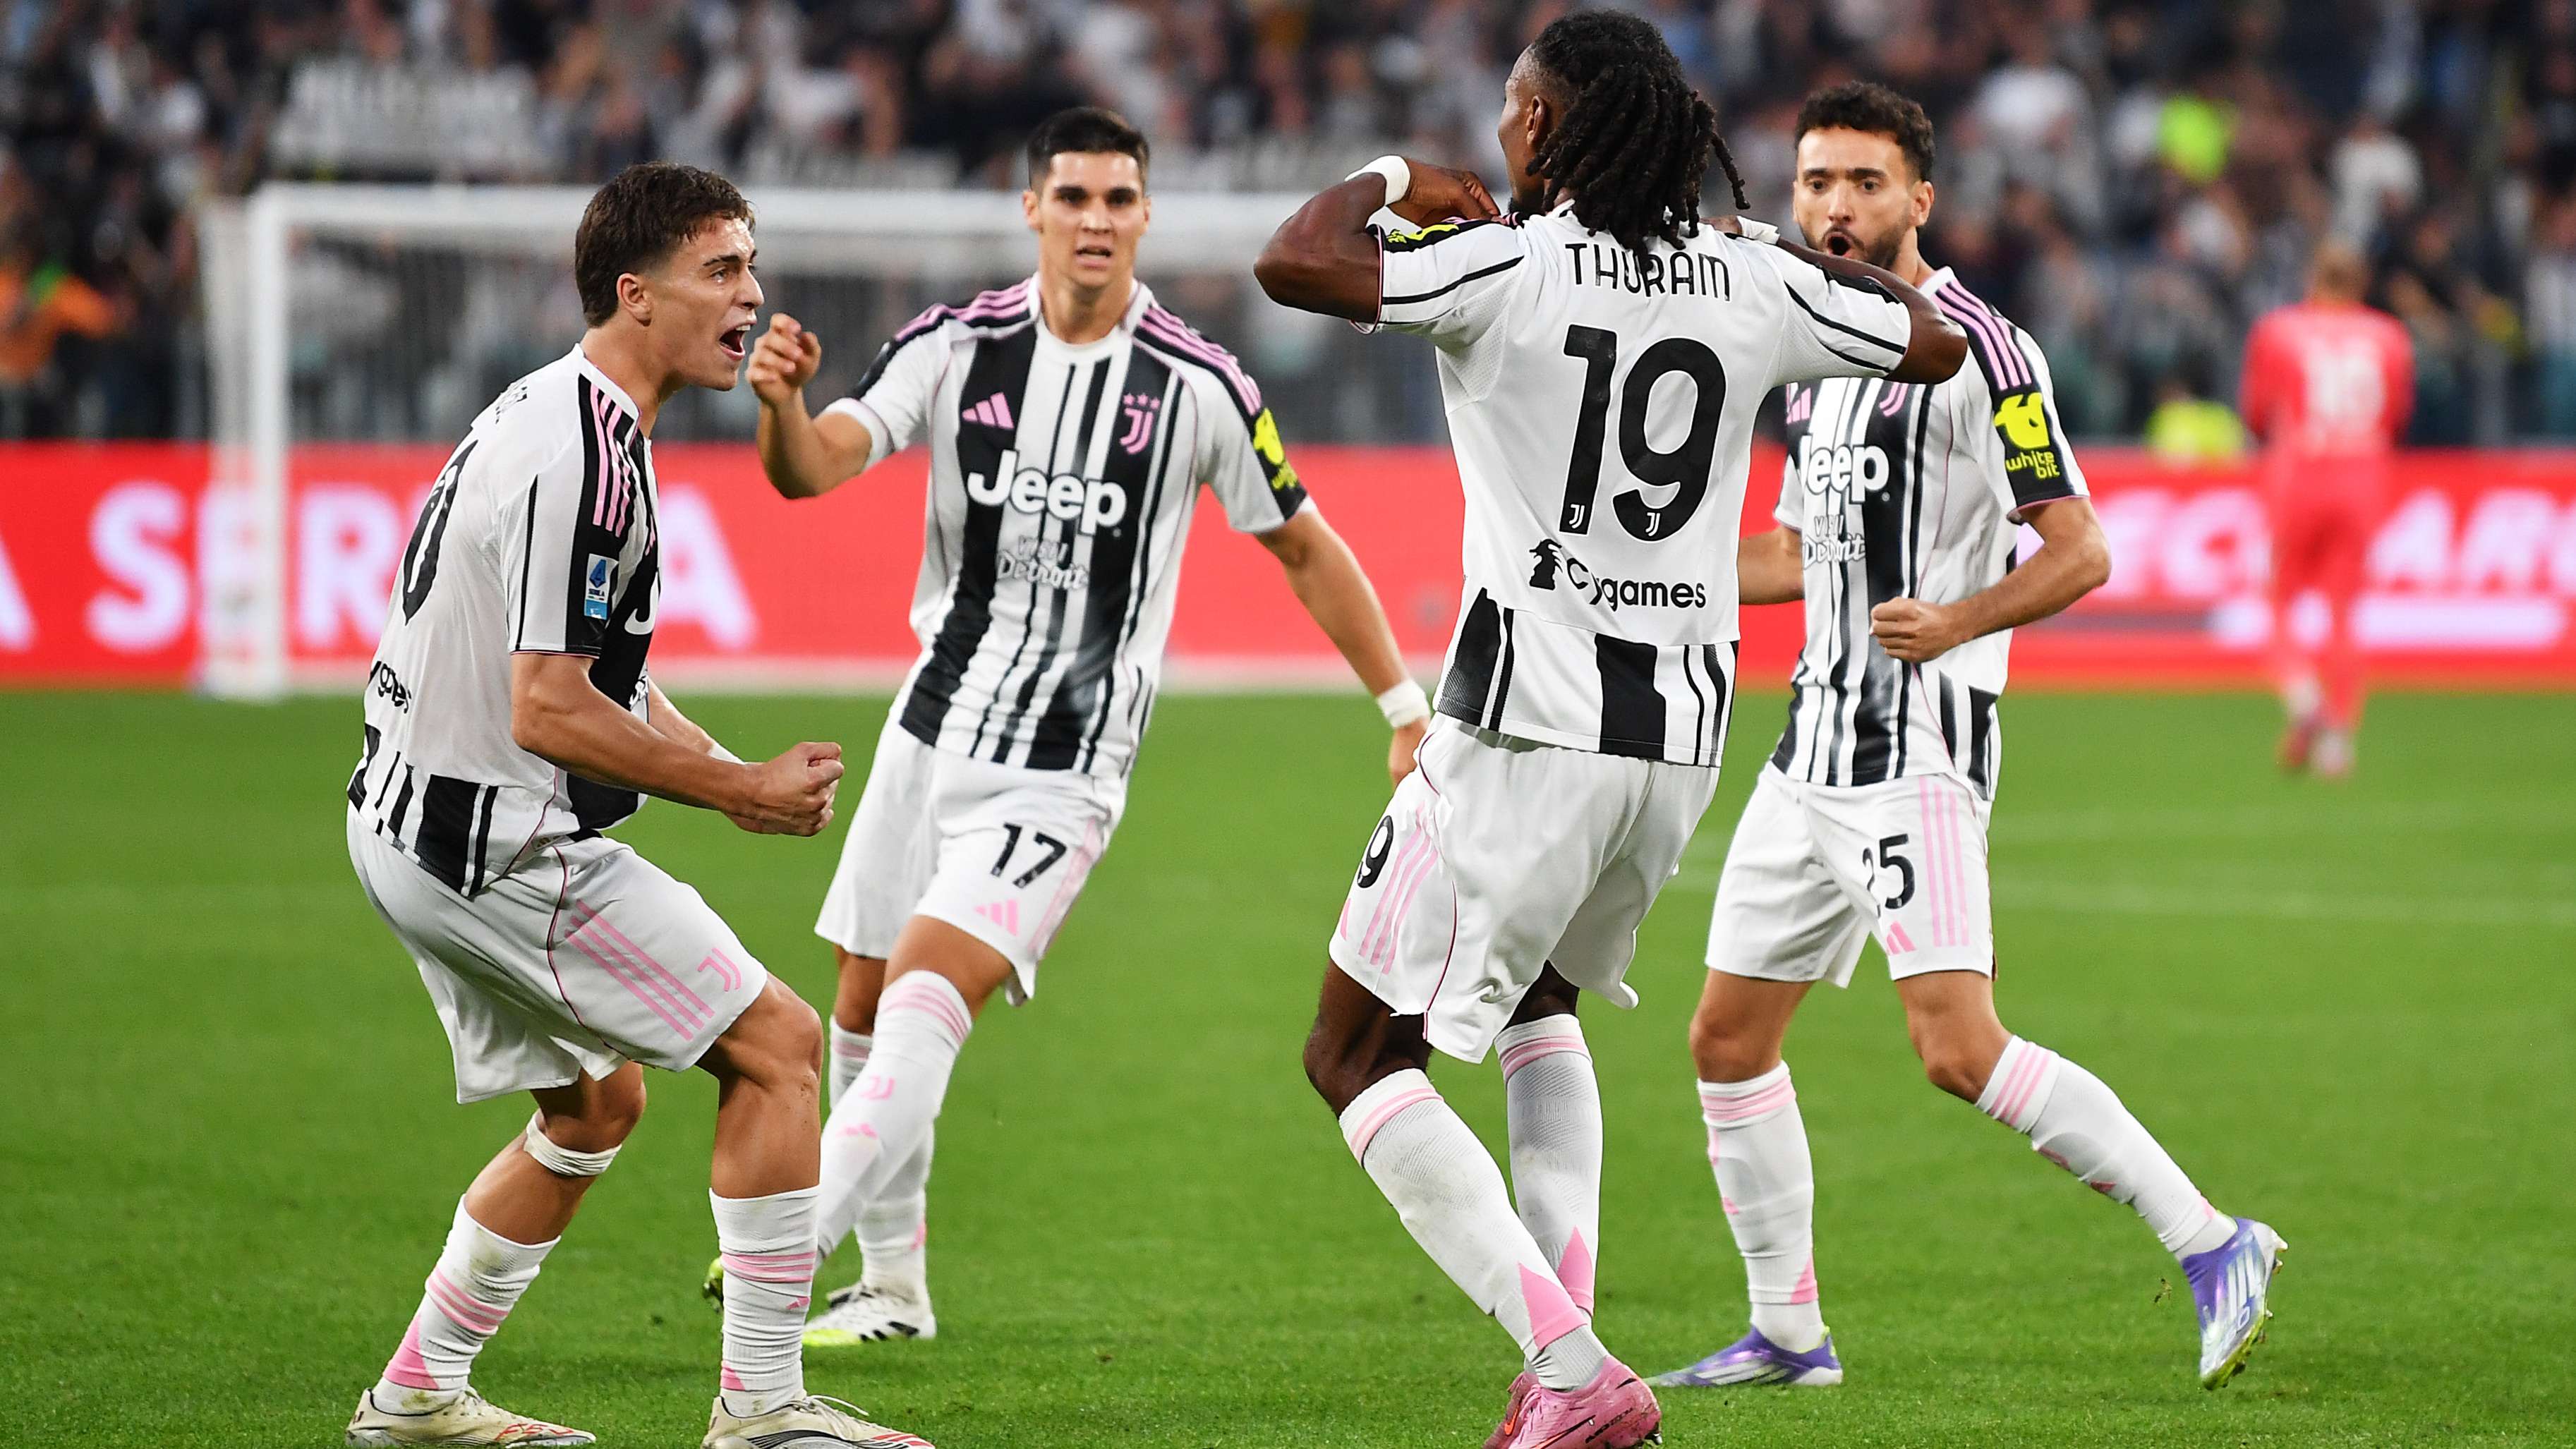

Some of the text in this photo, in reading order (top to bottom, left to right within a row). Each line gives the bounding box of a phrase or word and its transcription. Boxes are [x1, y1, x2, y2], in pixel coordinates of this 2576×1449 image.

[1564, 243, 1730, 302] THURAM
[1559, 324, 1727, 542] 19
[2004, 450, 2055, 471] white
[967, 449, 1127, 536] Jeep
[2036, 462, 2060, 479] bit
[990, 821, 1068, 890] 17
[1357, 815, 1394, 889] 9
